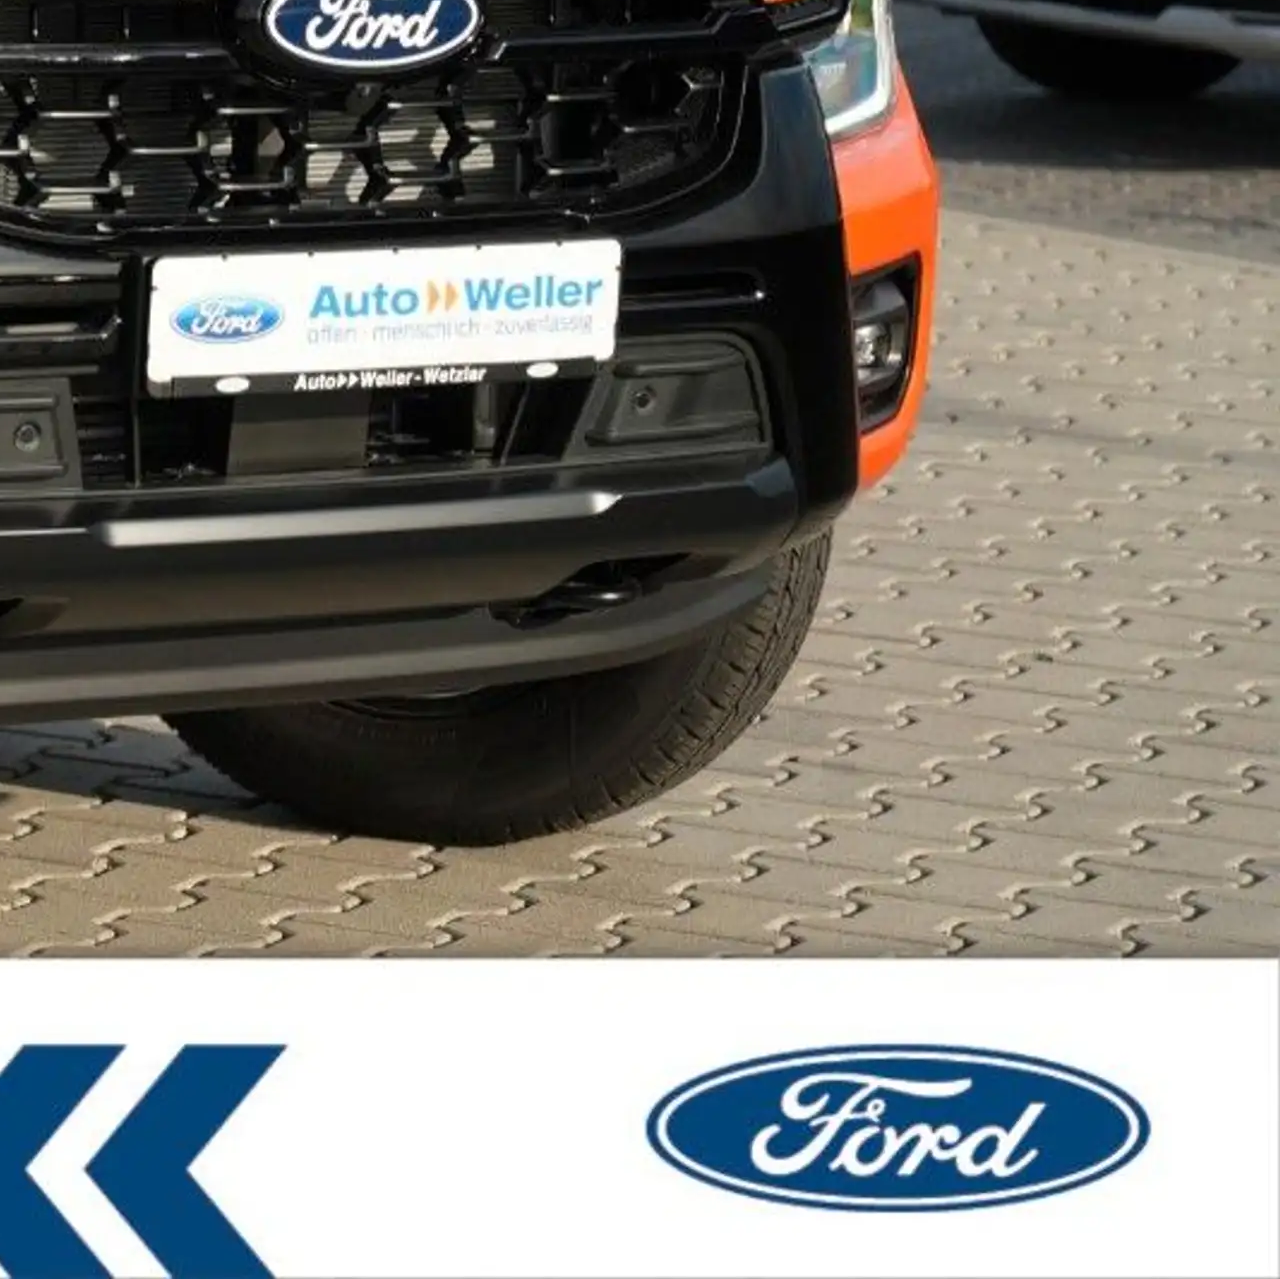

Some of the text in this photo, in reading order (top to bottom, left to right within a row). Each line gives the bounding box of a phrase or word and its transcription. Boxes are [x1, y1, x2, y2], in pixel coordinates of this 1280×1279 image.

[308, 275, 603, 319] Auto Weller
[293, 372, 338, 391] Auto
